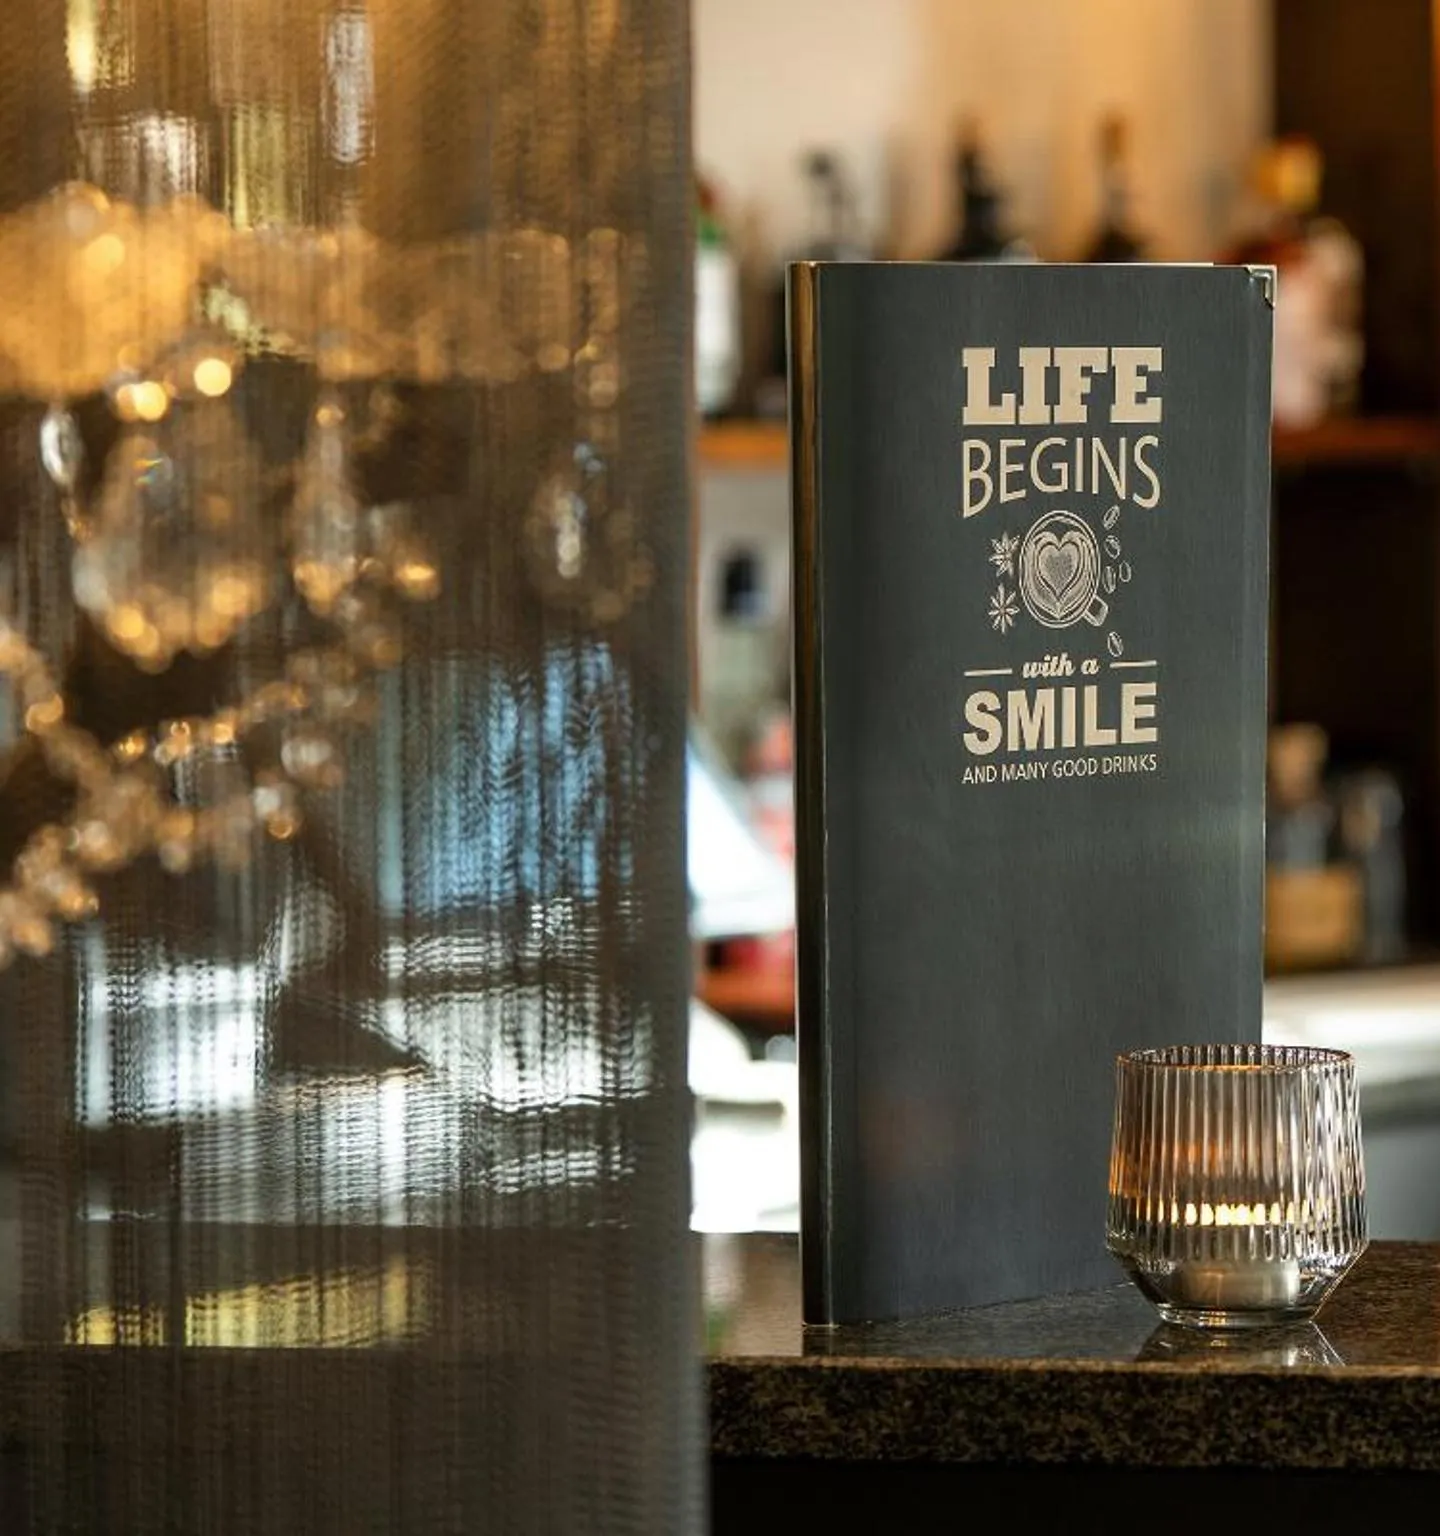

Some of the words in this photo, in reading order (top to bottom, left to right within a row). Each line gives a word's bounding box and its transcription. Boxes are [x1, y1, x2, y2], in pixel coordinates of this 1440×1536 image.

[962, 347, 1162, 425] LIFE
[962, 435, 1161, 519] BEGINS
[1022, 652, 1076, 678] with
[1081, 657, 1100, 675] a
[963, 682, 1158, 755] SMILE
[961, 765, 998, 784] AND
[1001, 761, 1049, 783] MANY
[1052, 758, 1099, 778] GOOD
[1101, 754, 1158, 775] DRINKS
